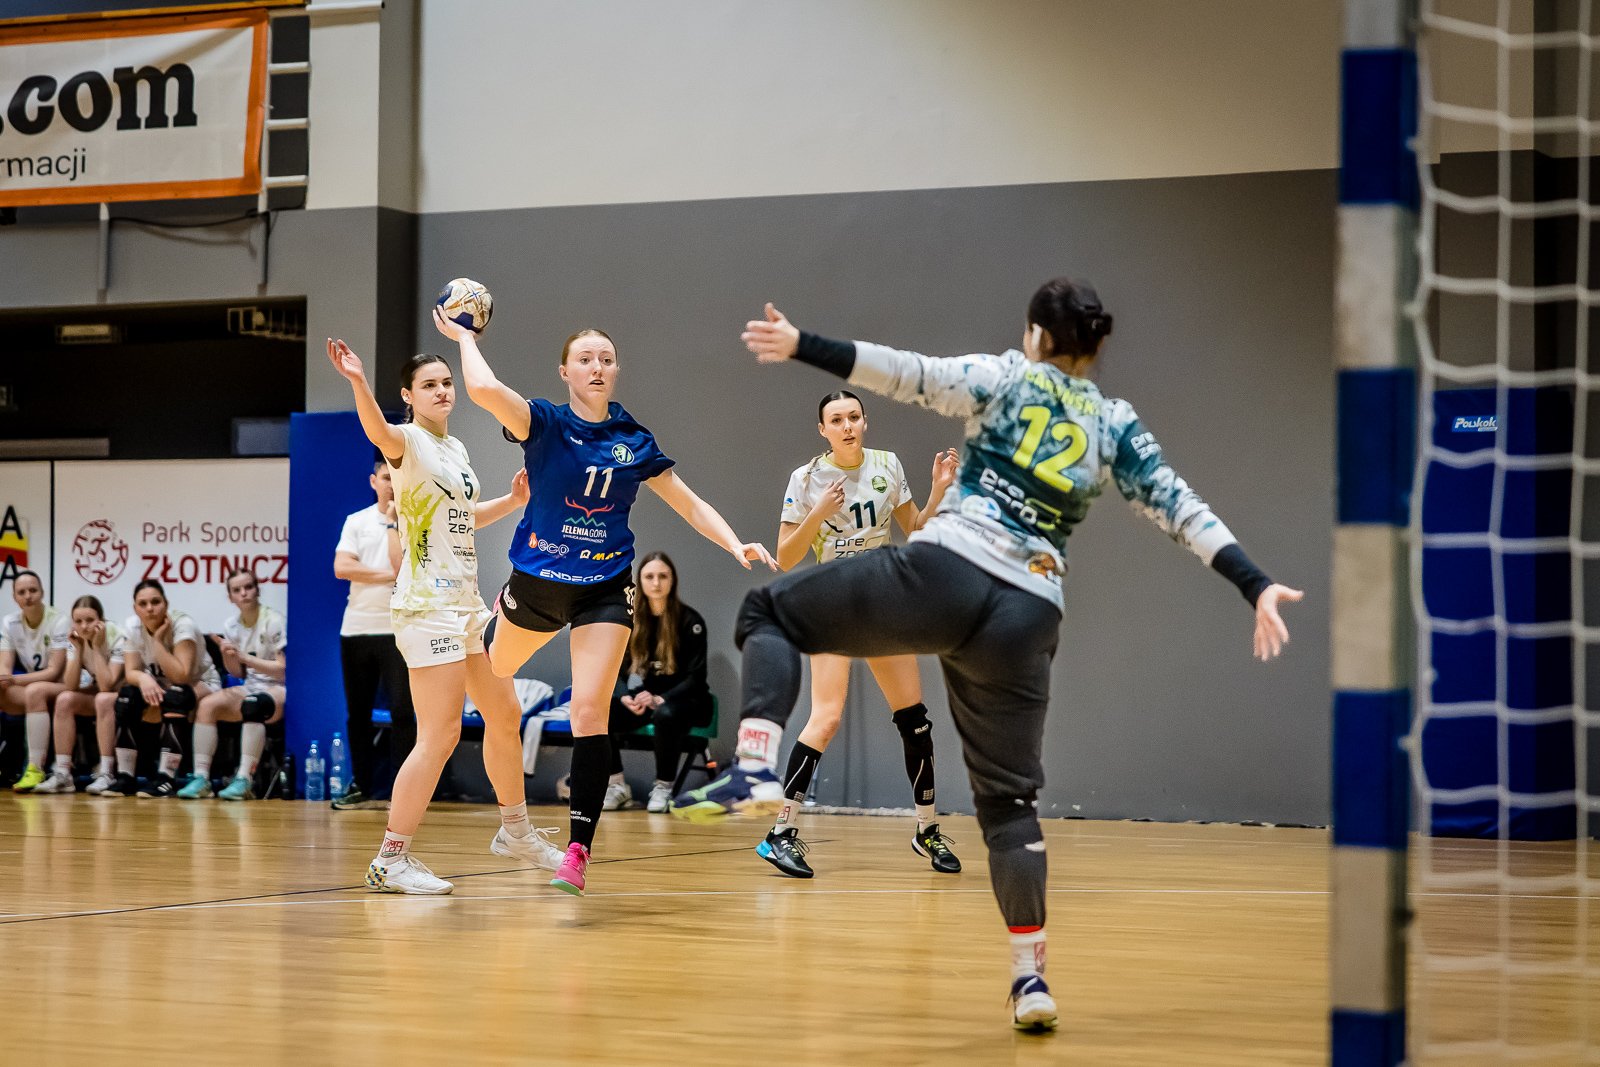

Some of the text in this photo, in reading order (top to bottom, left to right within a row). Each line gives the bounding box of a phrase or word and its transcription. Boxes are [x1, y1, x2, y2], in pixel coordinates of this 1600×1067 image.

[1012, 405, 1088, 494] 12
[461, 472, 474, 501] 5
[584, 465, 614, 499] 11
[849, 500, 877, 529] 11
[142, 520, 191, 543] Park
[561, 524, 589, 537] JELENIA
[835, 537, 865, 550] pre
[835, 548, 873, 560] ze
[430, 637, 450, 648] pre
[431, 644, 460, 655] zero
